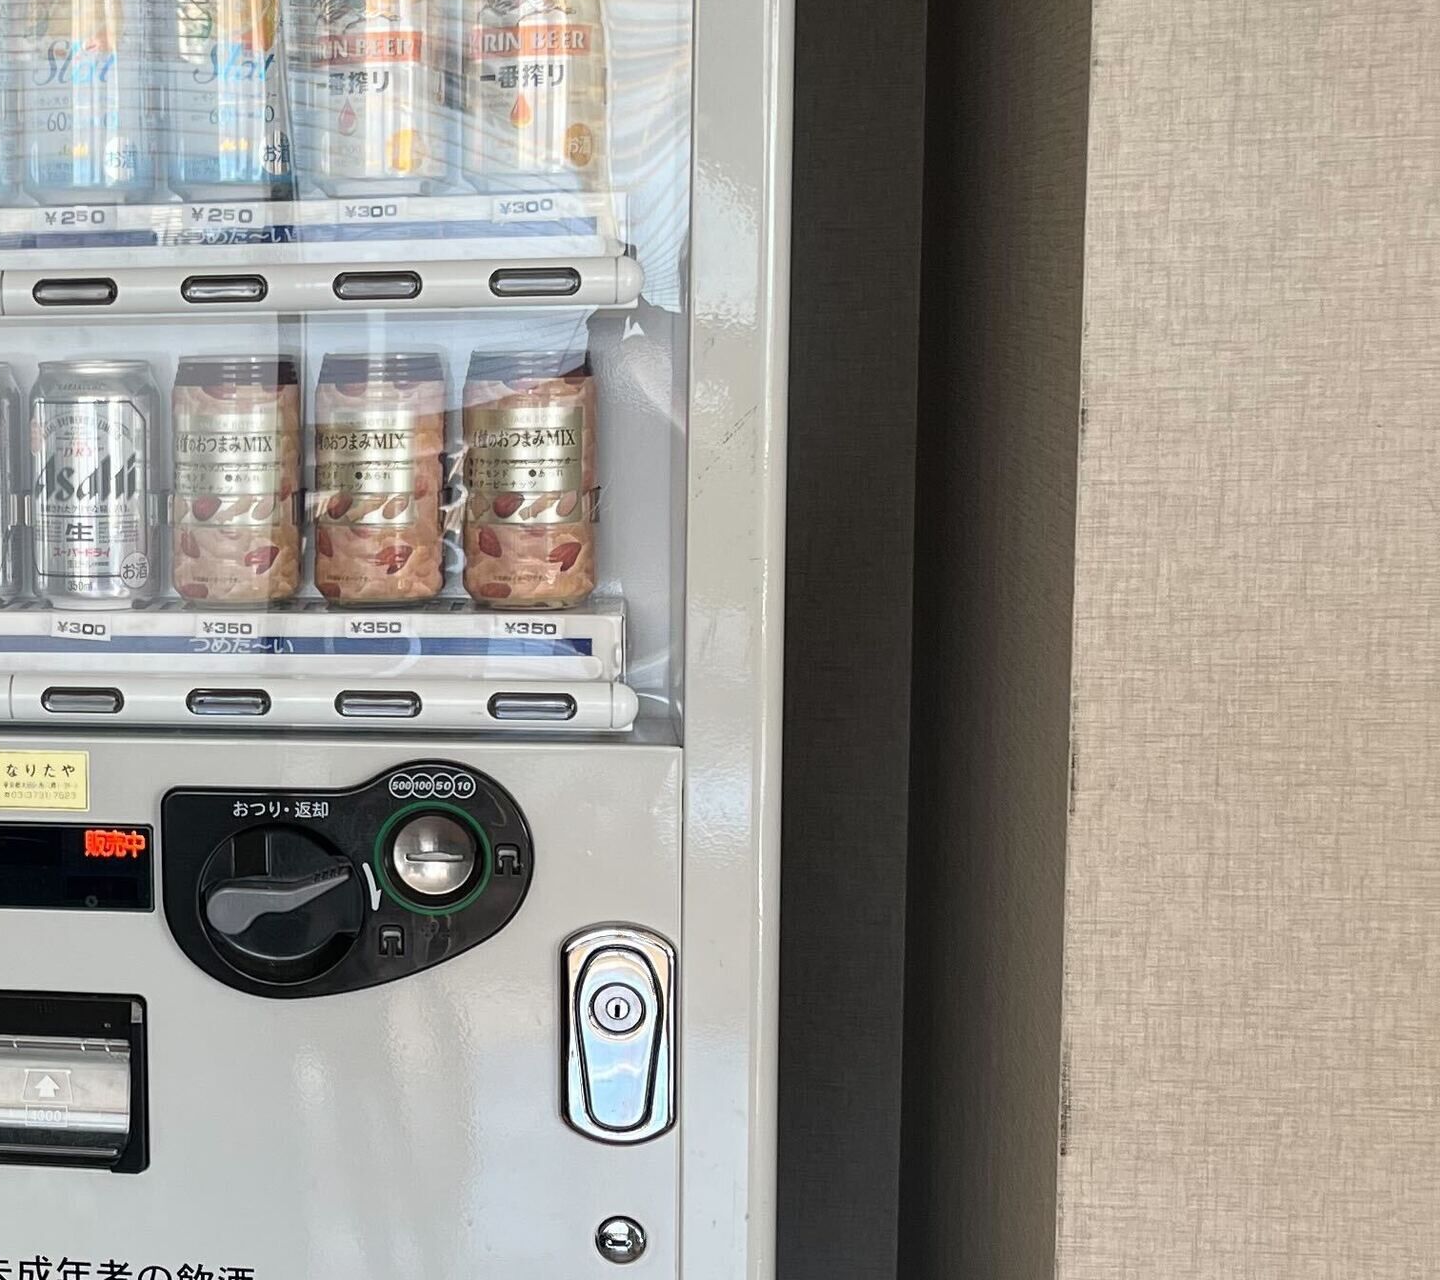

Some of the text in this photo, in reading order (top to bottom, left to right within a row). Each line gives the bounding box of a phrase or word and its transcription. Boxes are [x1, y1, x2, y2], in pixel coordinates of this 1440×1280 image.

[356, 37, 413, 57] BEER
[532, 30, 584, 49] BEER
[317, 72, 389, 94] 一番搾り
[480, 64, 563, 89] 一番搾り
[47, 113, 67, 131] 60
[345, 204, 397, 218] ¥300
[499, 199, 553, 214] ¥300
[46, 210, 105, 225] ¥250
[191, 207, 253, 223] ¥250
[36, 453, 136, 502] Asahi
[65, 523, 93, 542] 生
[53, 547, 110, 558] スーパードライ
[122, 562, 148, 580] お酒
[58, 622, 105, 635] ¥300
[203, 622, 252, 634] ¥350
[351, 622, 401, 634] ¥350
[505, 622, 557, 635] ¥350
[7, 763, 75, 778] なりたや
[392, 781, 471, 791] 500 100 50 10
[233, 801, 329, 819] おつり・返却
[84, 830, 146, 858] 販売中
